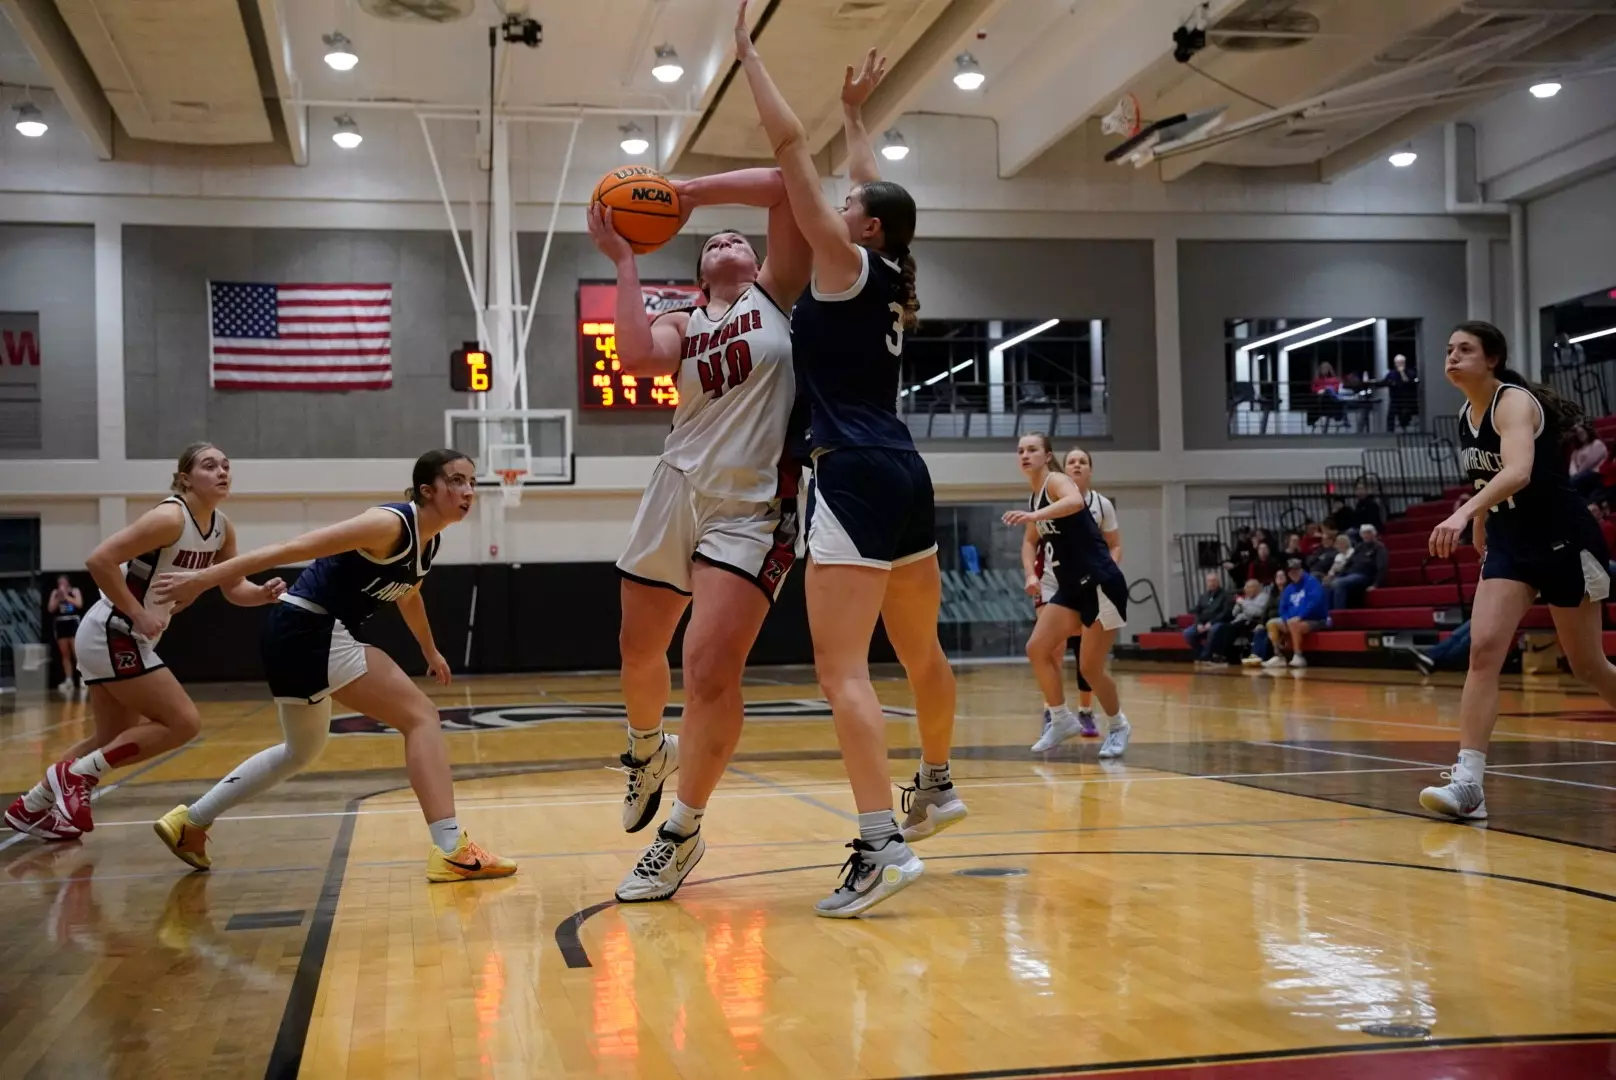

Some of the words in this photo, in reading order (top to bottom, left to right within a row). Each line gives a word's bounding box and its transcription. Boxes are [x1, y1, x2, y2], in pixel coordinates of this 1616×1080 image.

[631, 187, 673, 206] NCAA
[0, 329, 41, 366] W
[471, 363, 489, 391] 6
[697, 340, 753, 399] 40
[602, 386, 614, 406] 3
[623, 387, 637, 405] 4
[114, 650, 138, 670] R
